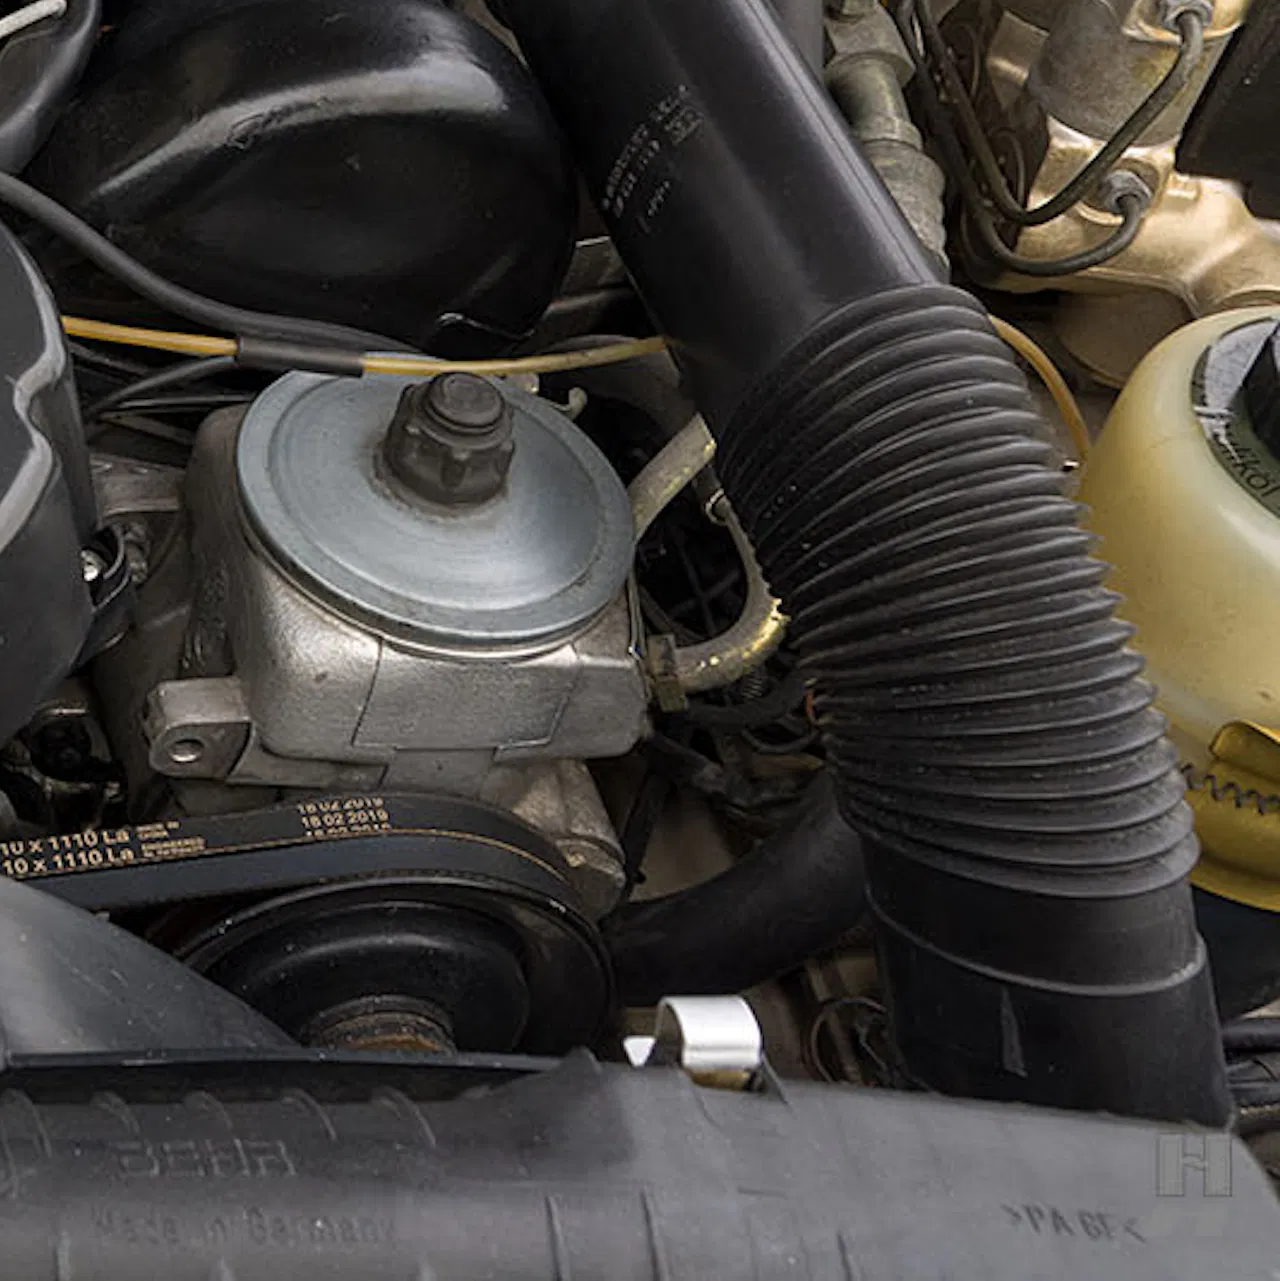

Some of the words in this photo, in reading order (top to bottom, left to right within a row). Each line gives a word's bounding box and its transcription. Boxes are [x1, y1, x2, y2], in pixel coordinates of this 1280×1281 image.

[322, 812, 344, 827] 02
[347, 808, 390, 825] 2019
[48, 831, 99, 851] 1110
[3, 856, 30, 875] 10
[52, 850, 104, 869] 1110
[106, 847, 135, 863] La
